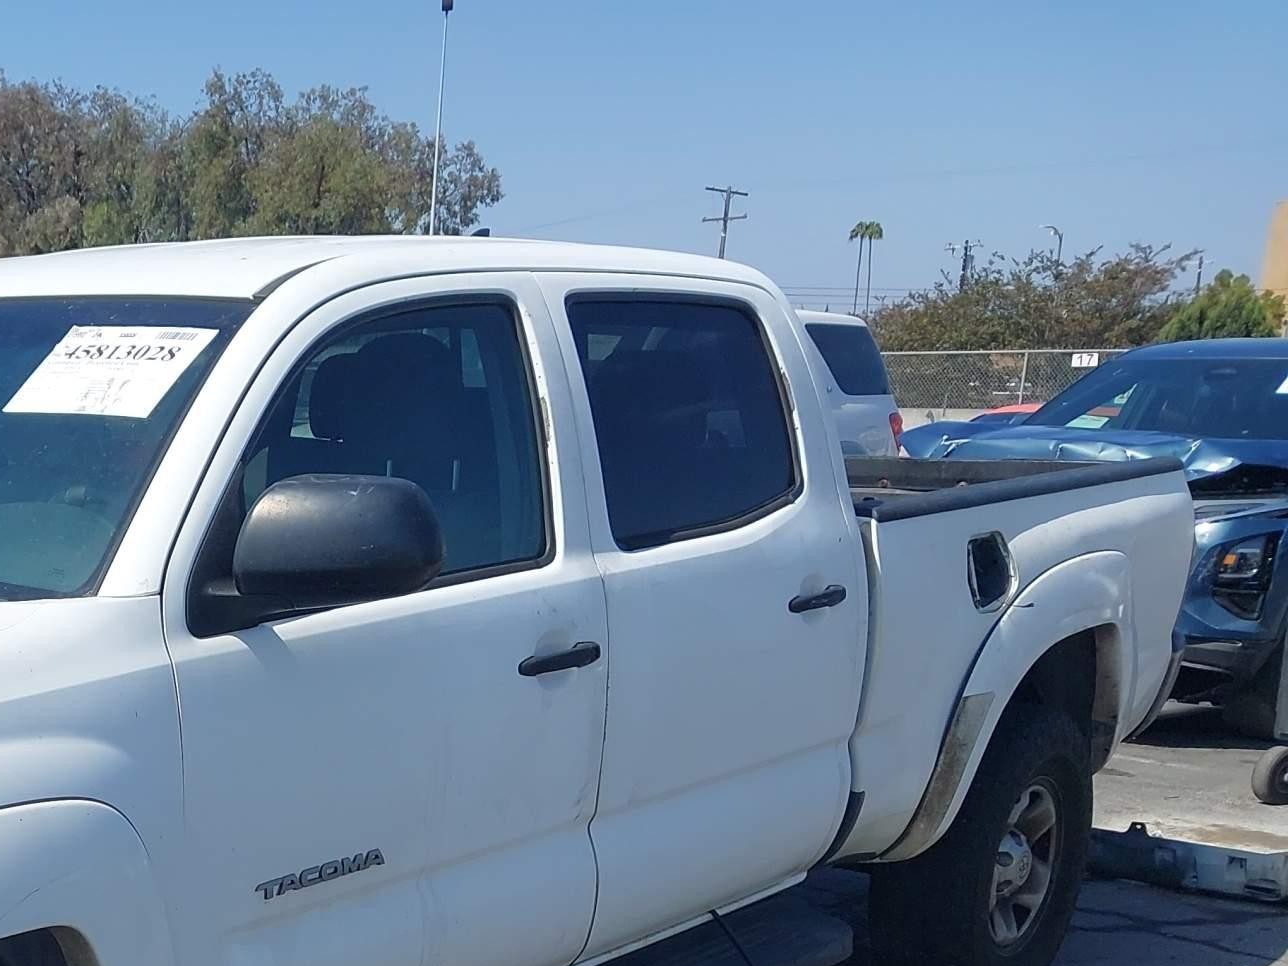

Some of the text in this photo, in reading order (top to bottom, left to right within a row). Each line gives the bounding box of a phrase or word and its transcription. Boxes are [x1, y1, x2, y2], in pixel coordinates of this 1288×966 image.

[64, 344, 182, 362] 45813028
[1076, 353, 1095, 366] 17
[254, 847, 386, 901] TACOMA
